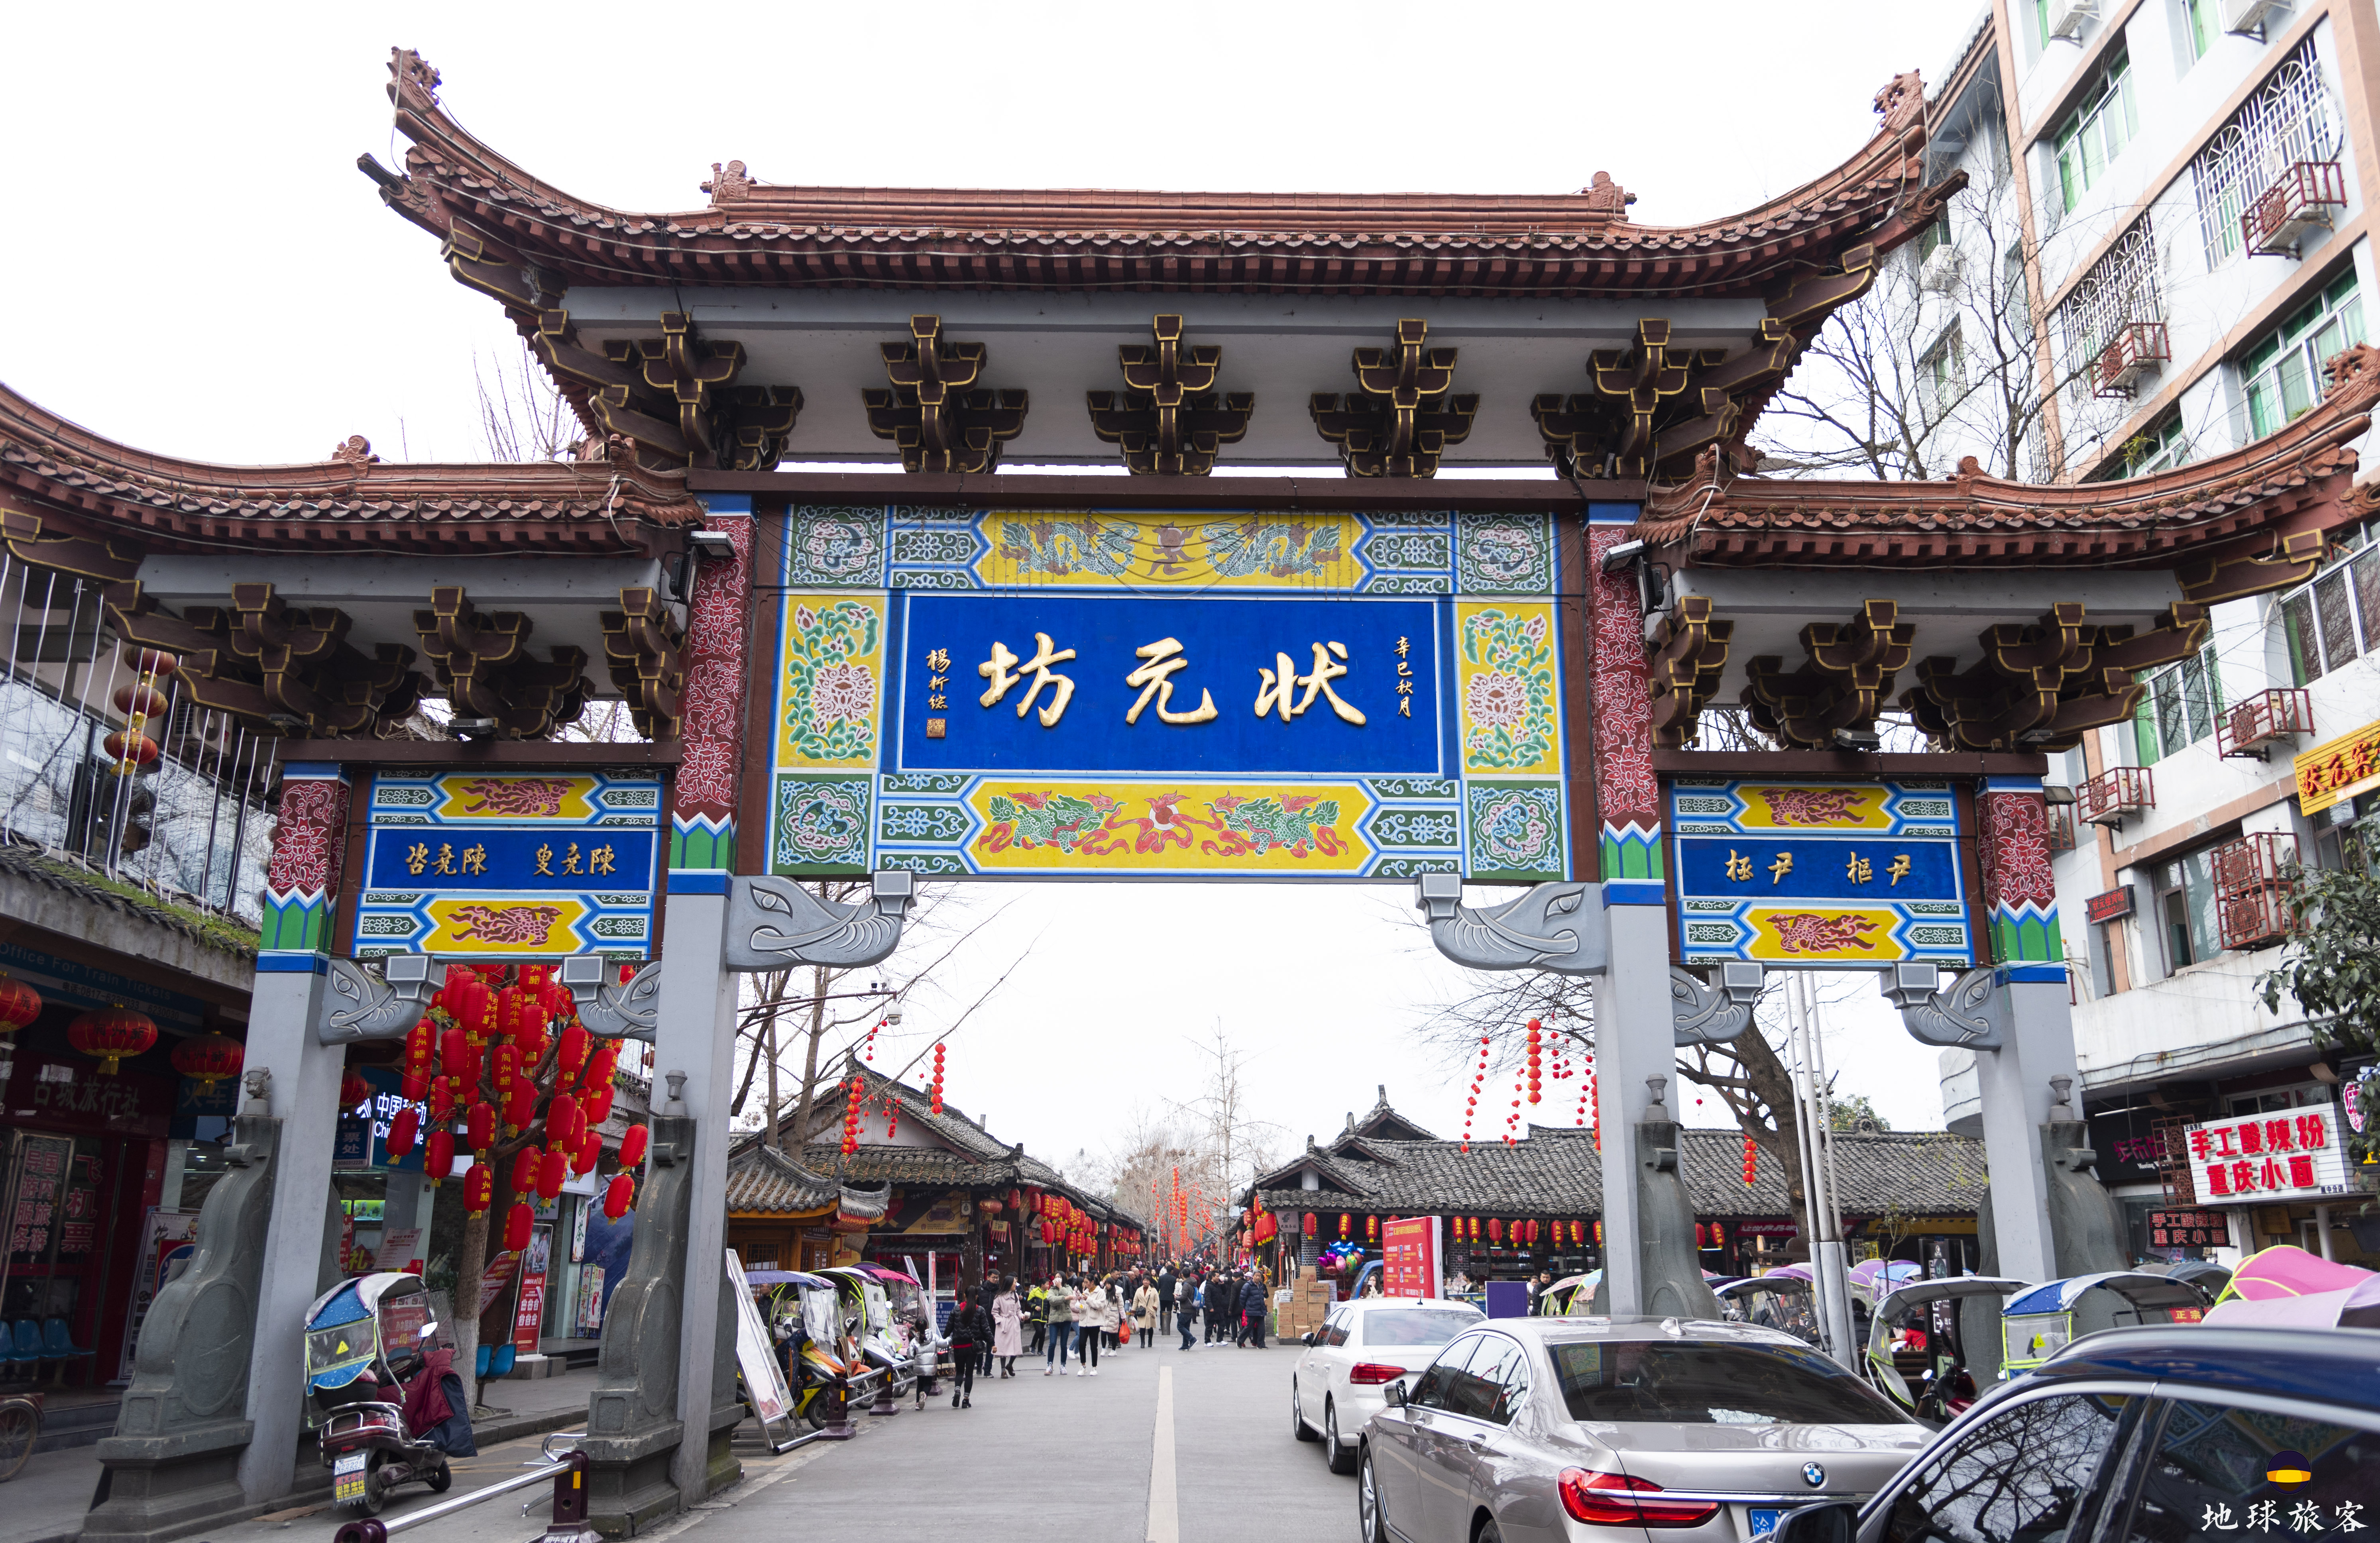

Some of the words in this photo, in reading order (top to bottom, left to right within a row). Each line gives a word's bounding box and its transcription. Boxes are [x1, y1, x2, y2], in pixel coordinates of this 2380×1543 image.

[979, 632, 1366, 726] 状元坊
[1394, 636, 1413, 717] 辛巳秋月
[53, 958, 77, 973] For
[85, 967, 119, 985] Train
[126, 978, 171, 1000] Tickets
[2191, 1113, 2324, 1160] 手工酸辣粉
[2207, 1155, 2314, 1196] 重庆小面
[61, 1154, 103, 1254] 飞机票
[2152, 1213, 2223, 1227] 手工酸辣粉
[2153, 1229, 2225, 1244] 重庆小面
[580, 1269, 590, 1323] 欢迎光临
[2175, 1310, 2202, 1320] 正宗
